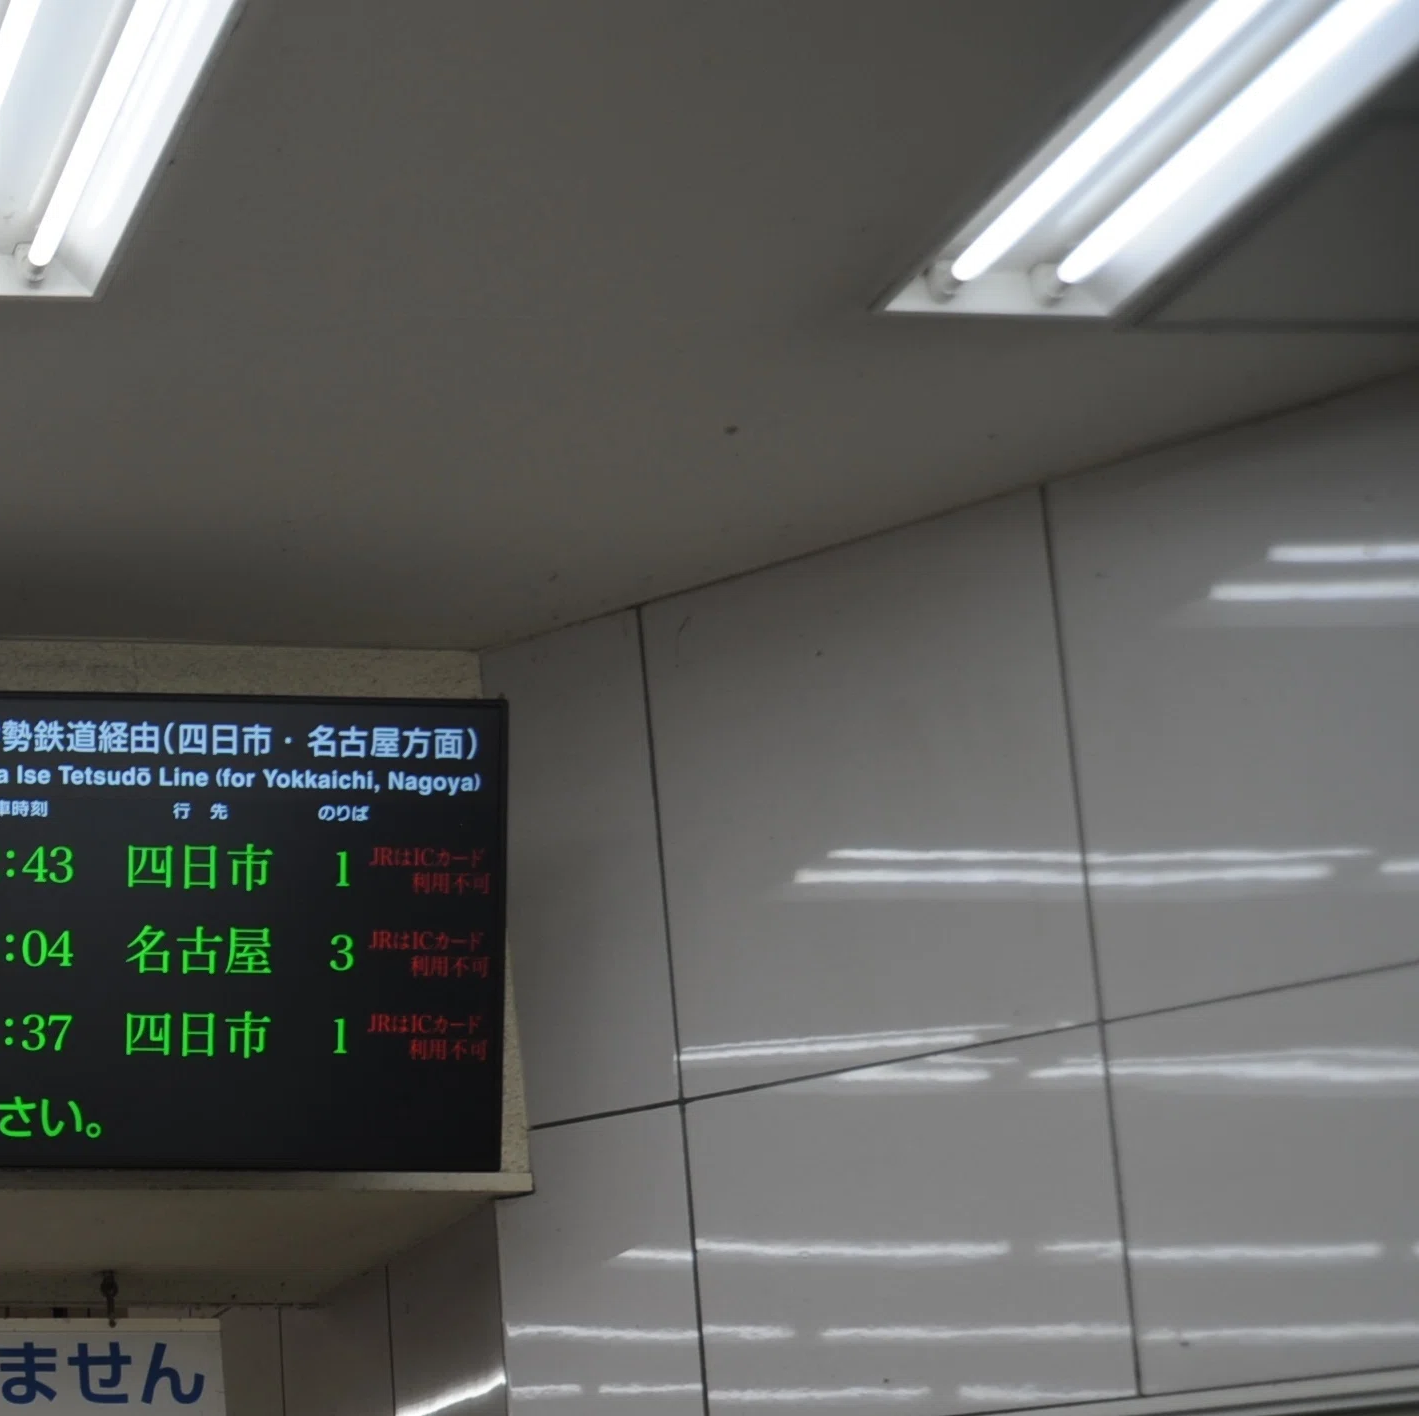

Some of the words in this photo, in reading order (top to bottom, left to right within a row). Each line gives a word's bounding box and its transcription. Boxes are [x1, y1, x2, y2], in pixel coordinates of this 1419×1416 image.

[17, 765, 51, 784] Ise
[58, 765, 151, 786] Tetsudō
[159, 767, 209, 787] Line
[216, 768, 256, 787] (for
[263, 769, 380, 793] Yokkaichi,
[388, 771, 481, 796] Nagoya)
[318, 805, 370, 821] のりば
[128, 844, 273, 891] 四日市
[337, 851, 349, 886] 1
[126, 925, 271, 974] 名古屋
[330, 934, 354, 971] 3
[126, 1011, 271, 1058] 四日市
[334, 1018, 347, 1053] 1
